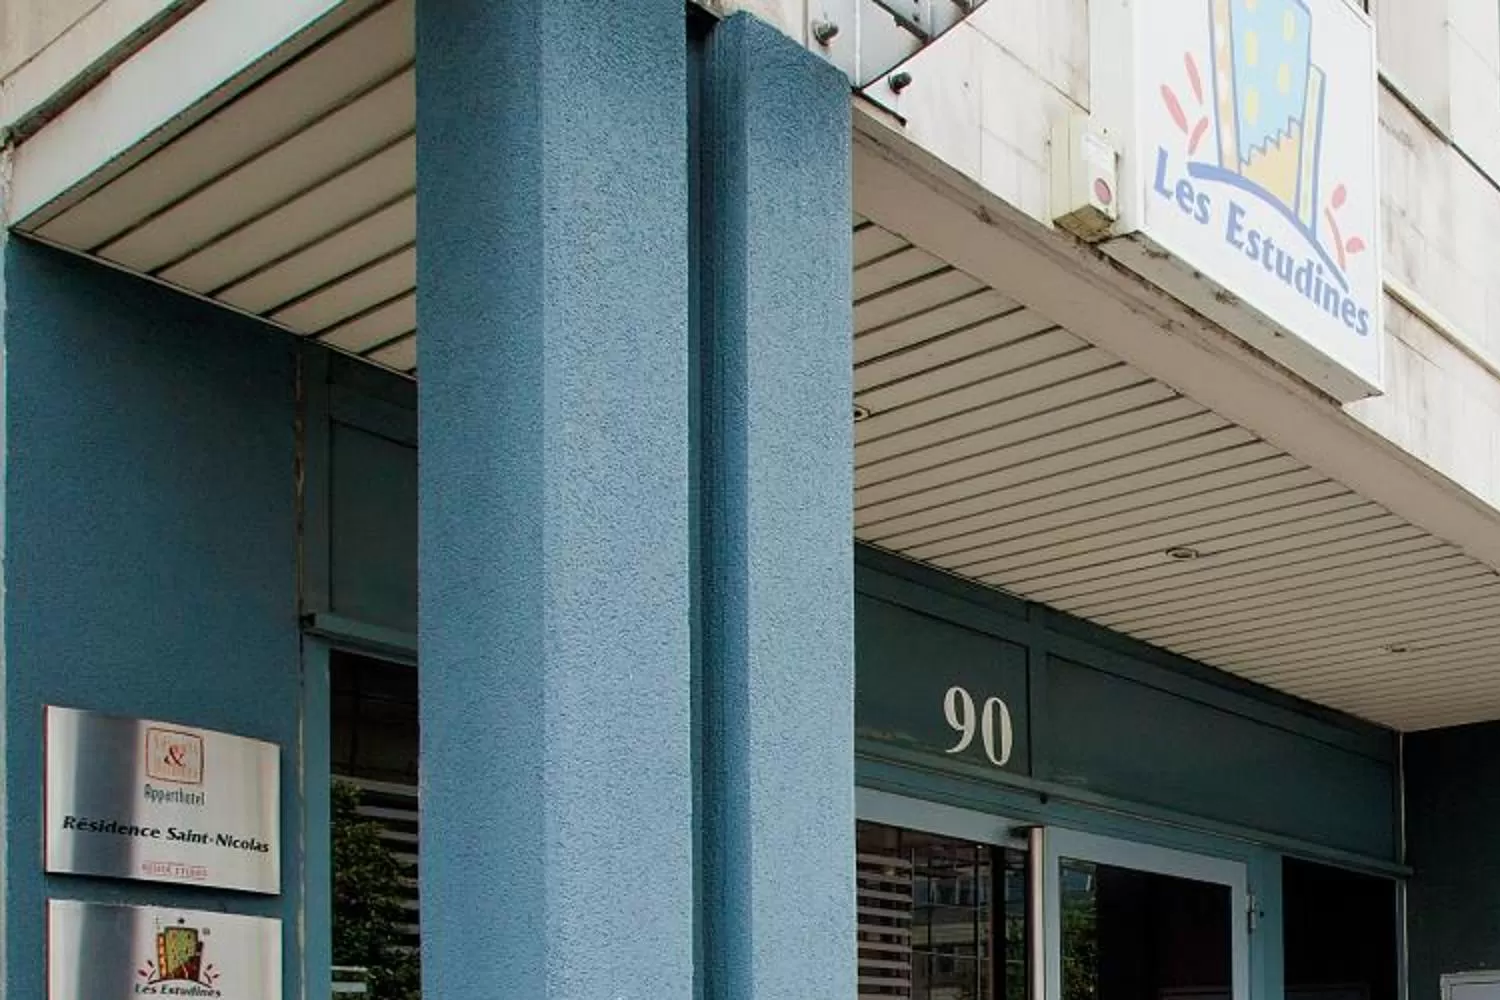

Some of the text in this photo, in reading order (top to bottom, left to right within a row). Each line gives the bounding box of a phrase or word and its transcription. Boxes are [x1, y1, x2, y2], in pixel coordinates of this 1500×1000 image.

[1153, 145, 1370, 336] Les Estudines
[943, 685, 1013, 766] 90
[62, 814, 270, 854] Résidence Saint-Nicolas
[134, 982, 222, 999] Les Estudines
